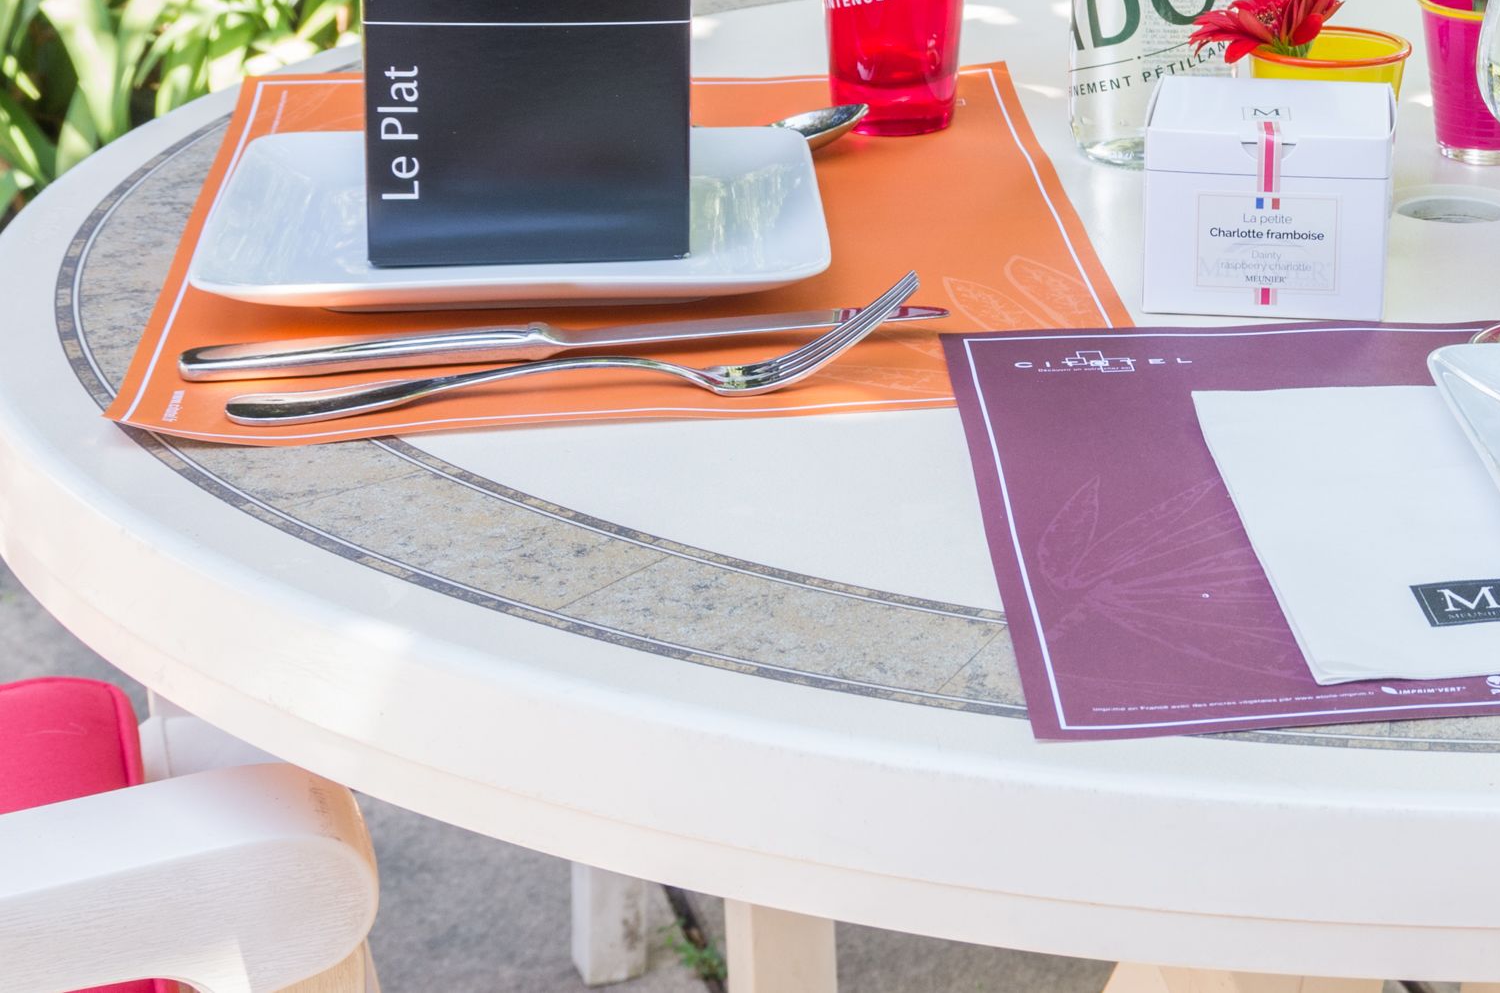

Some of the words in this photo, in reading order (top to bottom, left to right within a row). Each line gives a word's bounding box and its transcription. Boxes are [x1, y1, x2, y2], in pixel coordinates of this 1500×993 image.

[377, 64, 420, 140] Plat
[1253, 108, 1281, 117] M
[381, 156, 420, 200] Le
[1242, 213, 1258, 224] La
[1260, 213, 1293, 226] petite
[1209, 227, 1264, 239] Charlotte
[1266, 229, 1325, 241] framboise
[1251, 250, 1282, 261] Dainty
